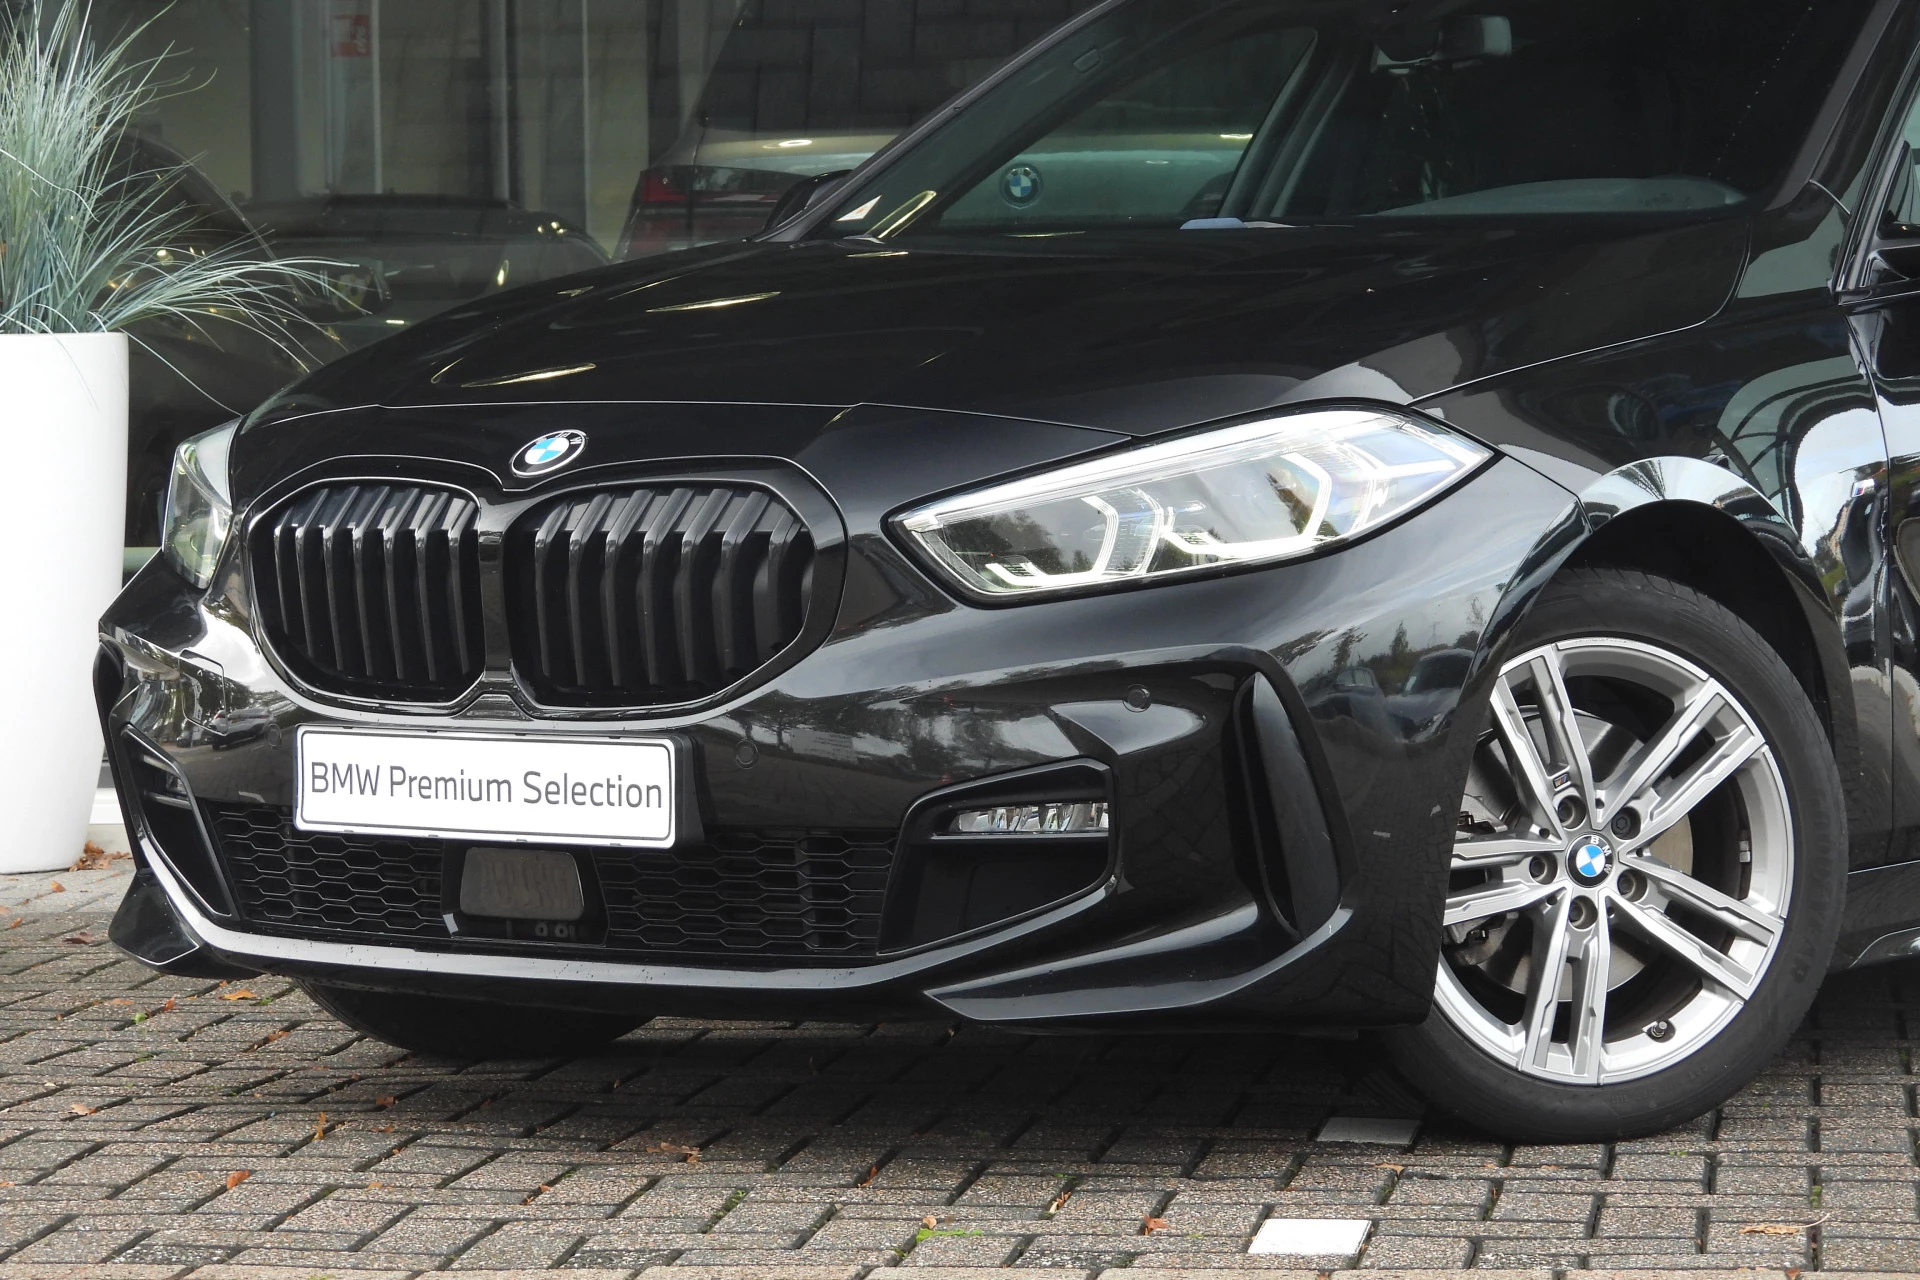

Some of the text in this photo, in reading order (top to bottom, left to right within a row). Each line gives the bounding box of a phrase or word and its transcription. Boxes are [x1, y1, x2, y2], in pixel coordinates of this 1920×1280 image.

[311, 761, 662, 809] BMW Premium Selection
[1590, 835, 1613, 875] BMW
